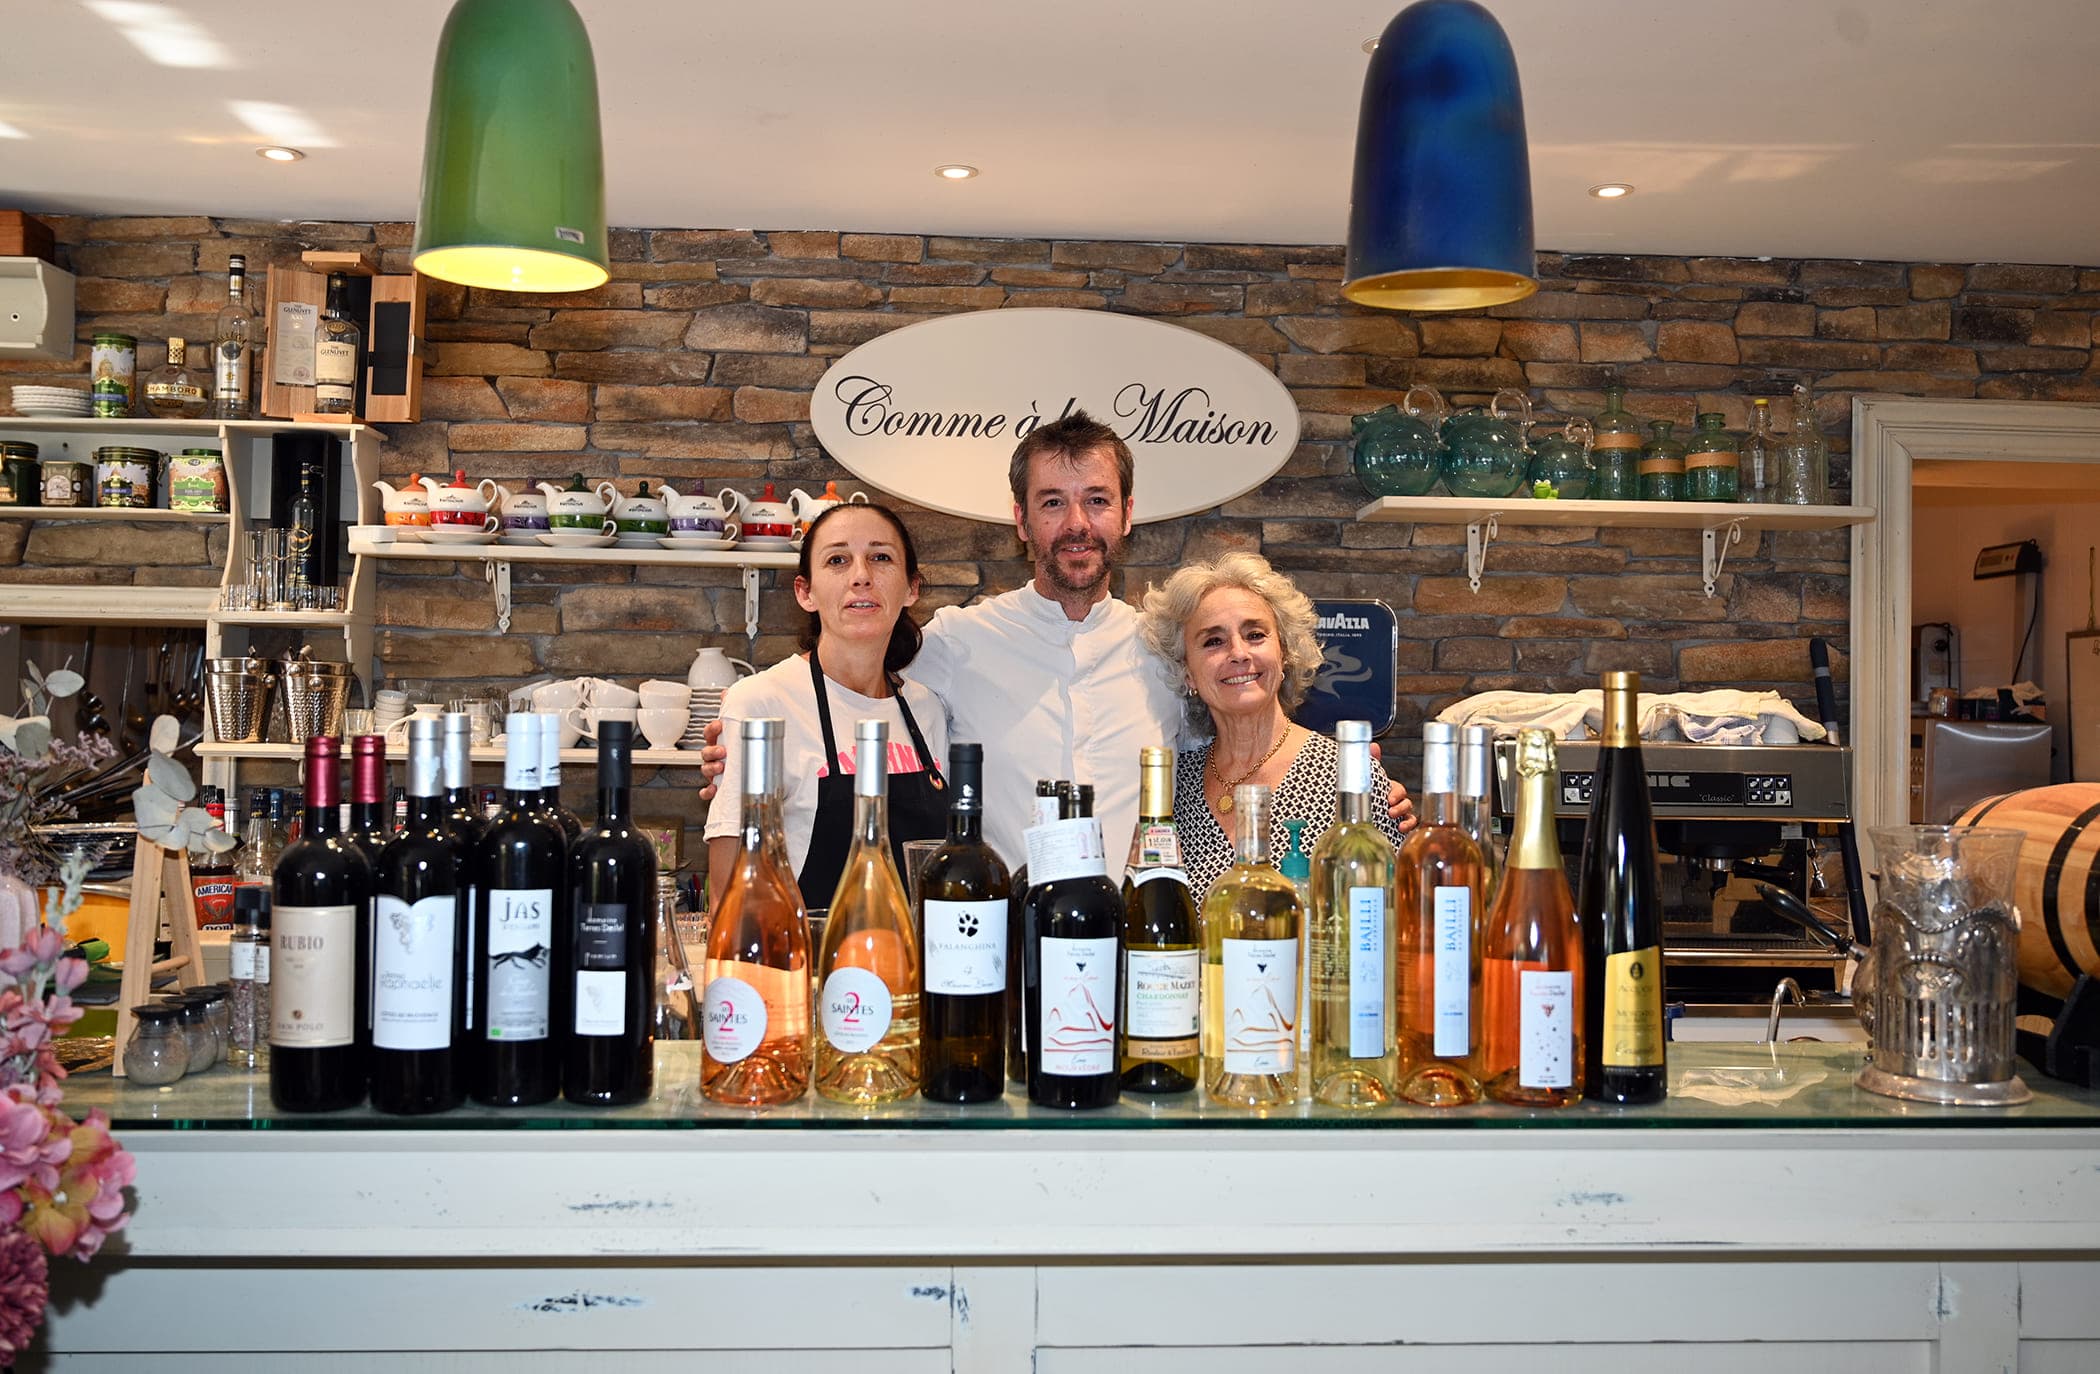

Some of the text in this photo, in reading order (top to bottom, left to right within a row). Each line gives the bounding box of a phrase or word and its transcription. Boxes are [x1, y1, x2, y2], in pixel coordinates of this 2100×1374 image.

[834, 375, 1006, 438] Comme
[1015, 399, 1041, 440] à
[1113, 383, 1278, 446] Maison
[1315, 612, 1370, 630] AVAZZA
[1647, 775, 1691, 788] NIC
[279, 935, 324, 951] RUBIO
[719, 1000, 735, 1032] 2
[843, 991, 861, 1023] 2
